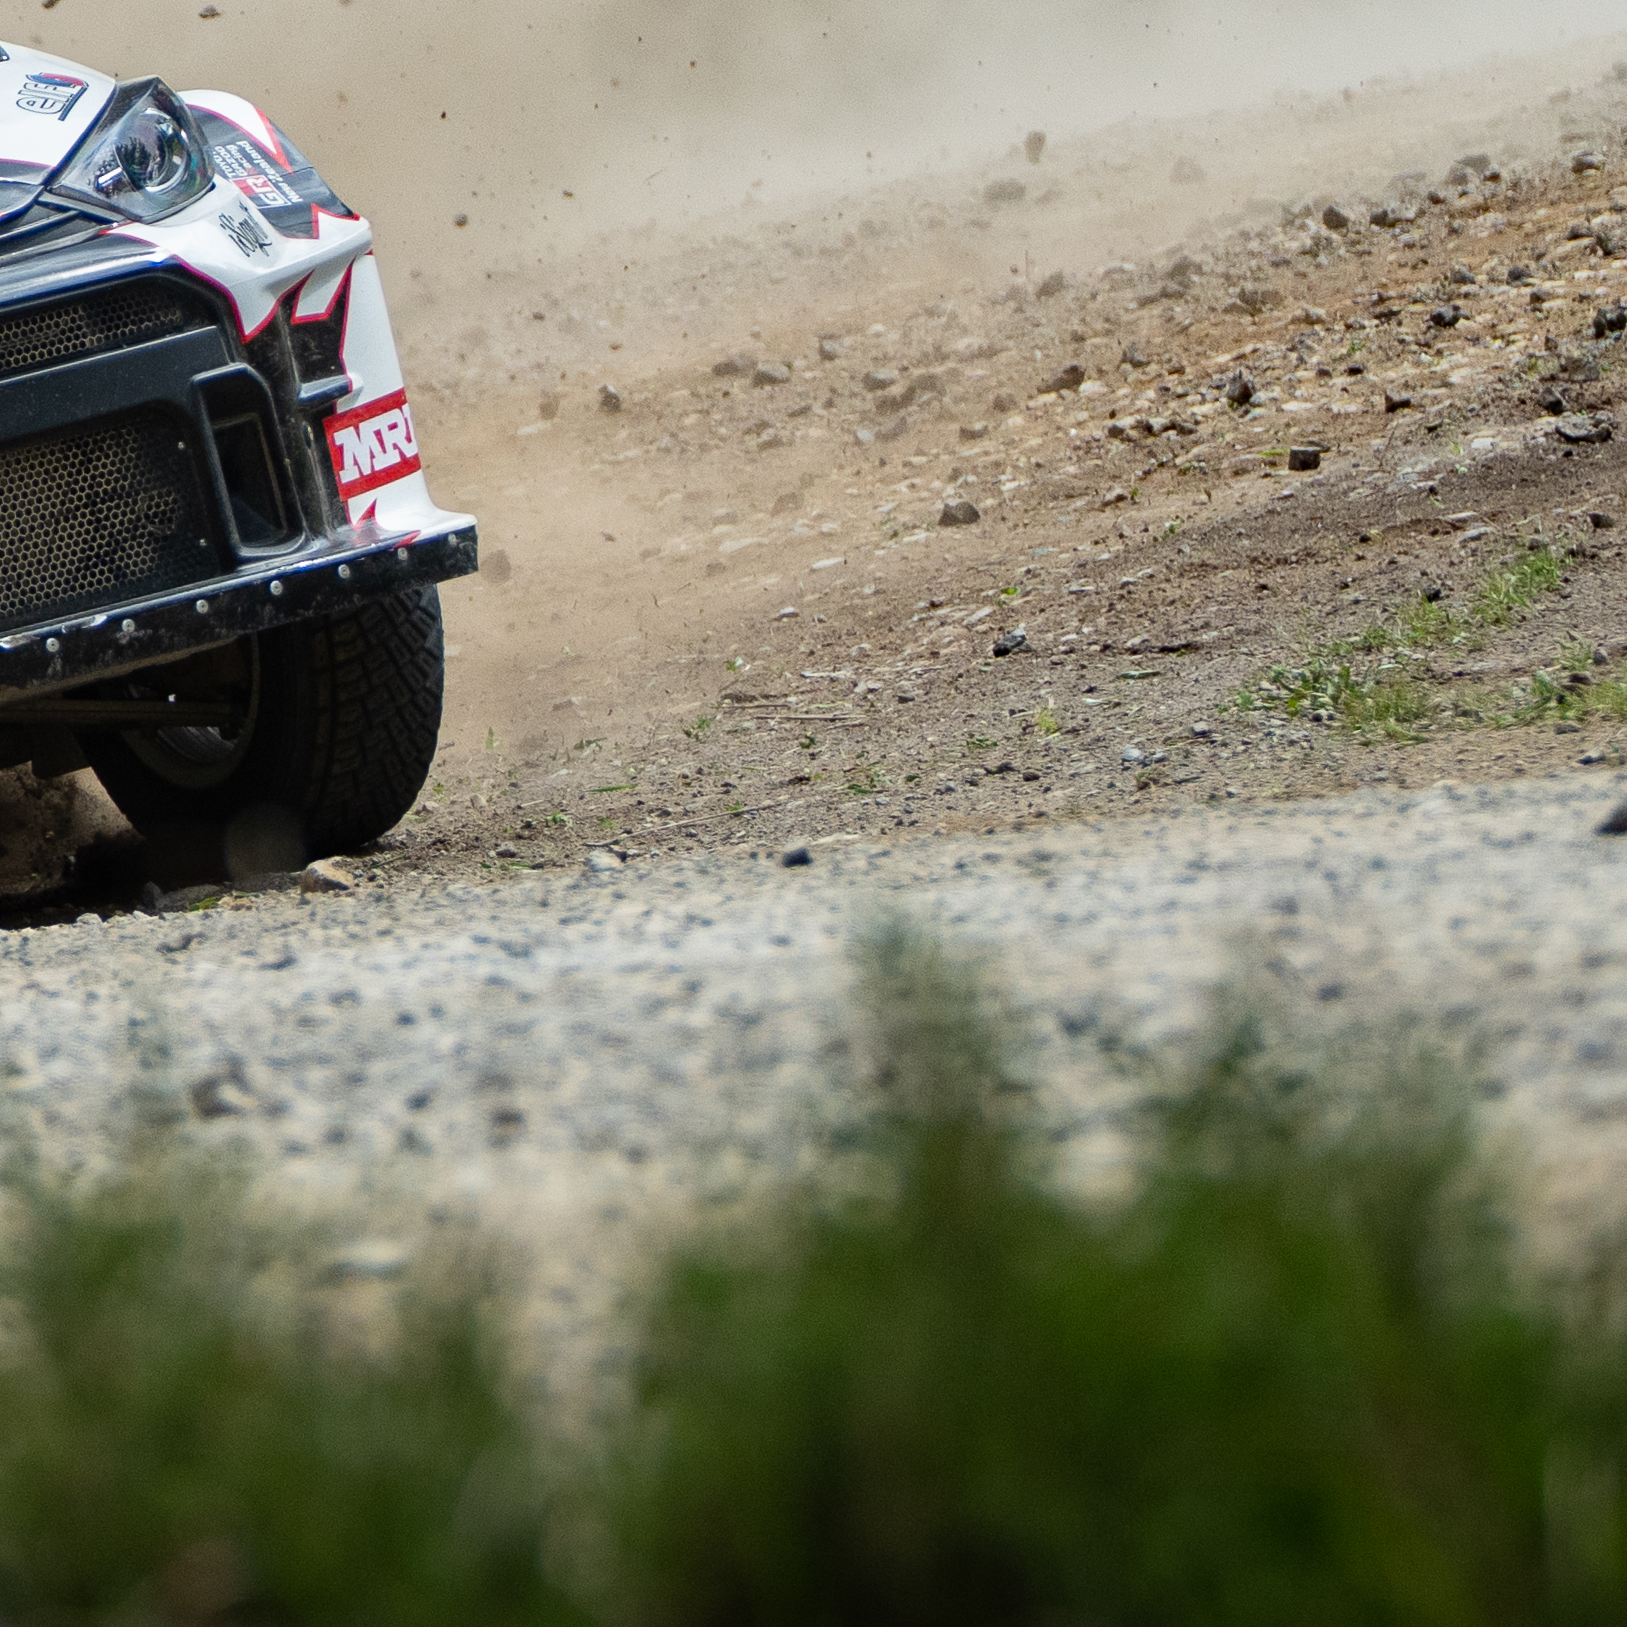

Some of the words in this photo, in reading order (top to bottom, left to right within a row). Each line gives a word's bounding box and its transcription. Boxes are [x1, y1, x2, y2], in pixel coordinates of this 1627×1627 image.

[15, 82, 76, 115] elf
[214, 146, 248, 176] GAZOO
[245, 177, 286, 204] GR
[277, 182, 303, 203] New
[333, 403, 418, 484] MR
